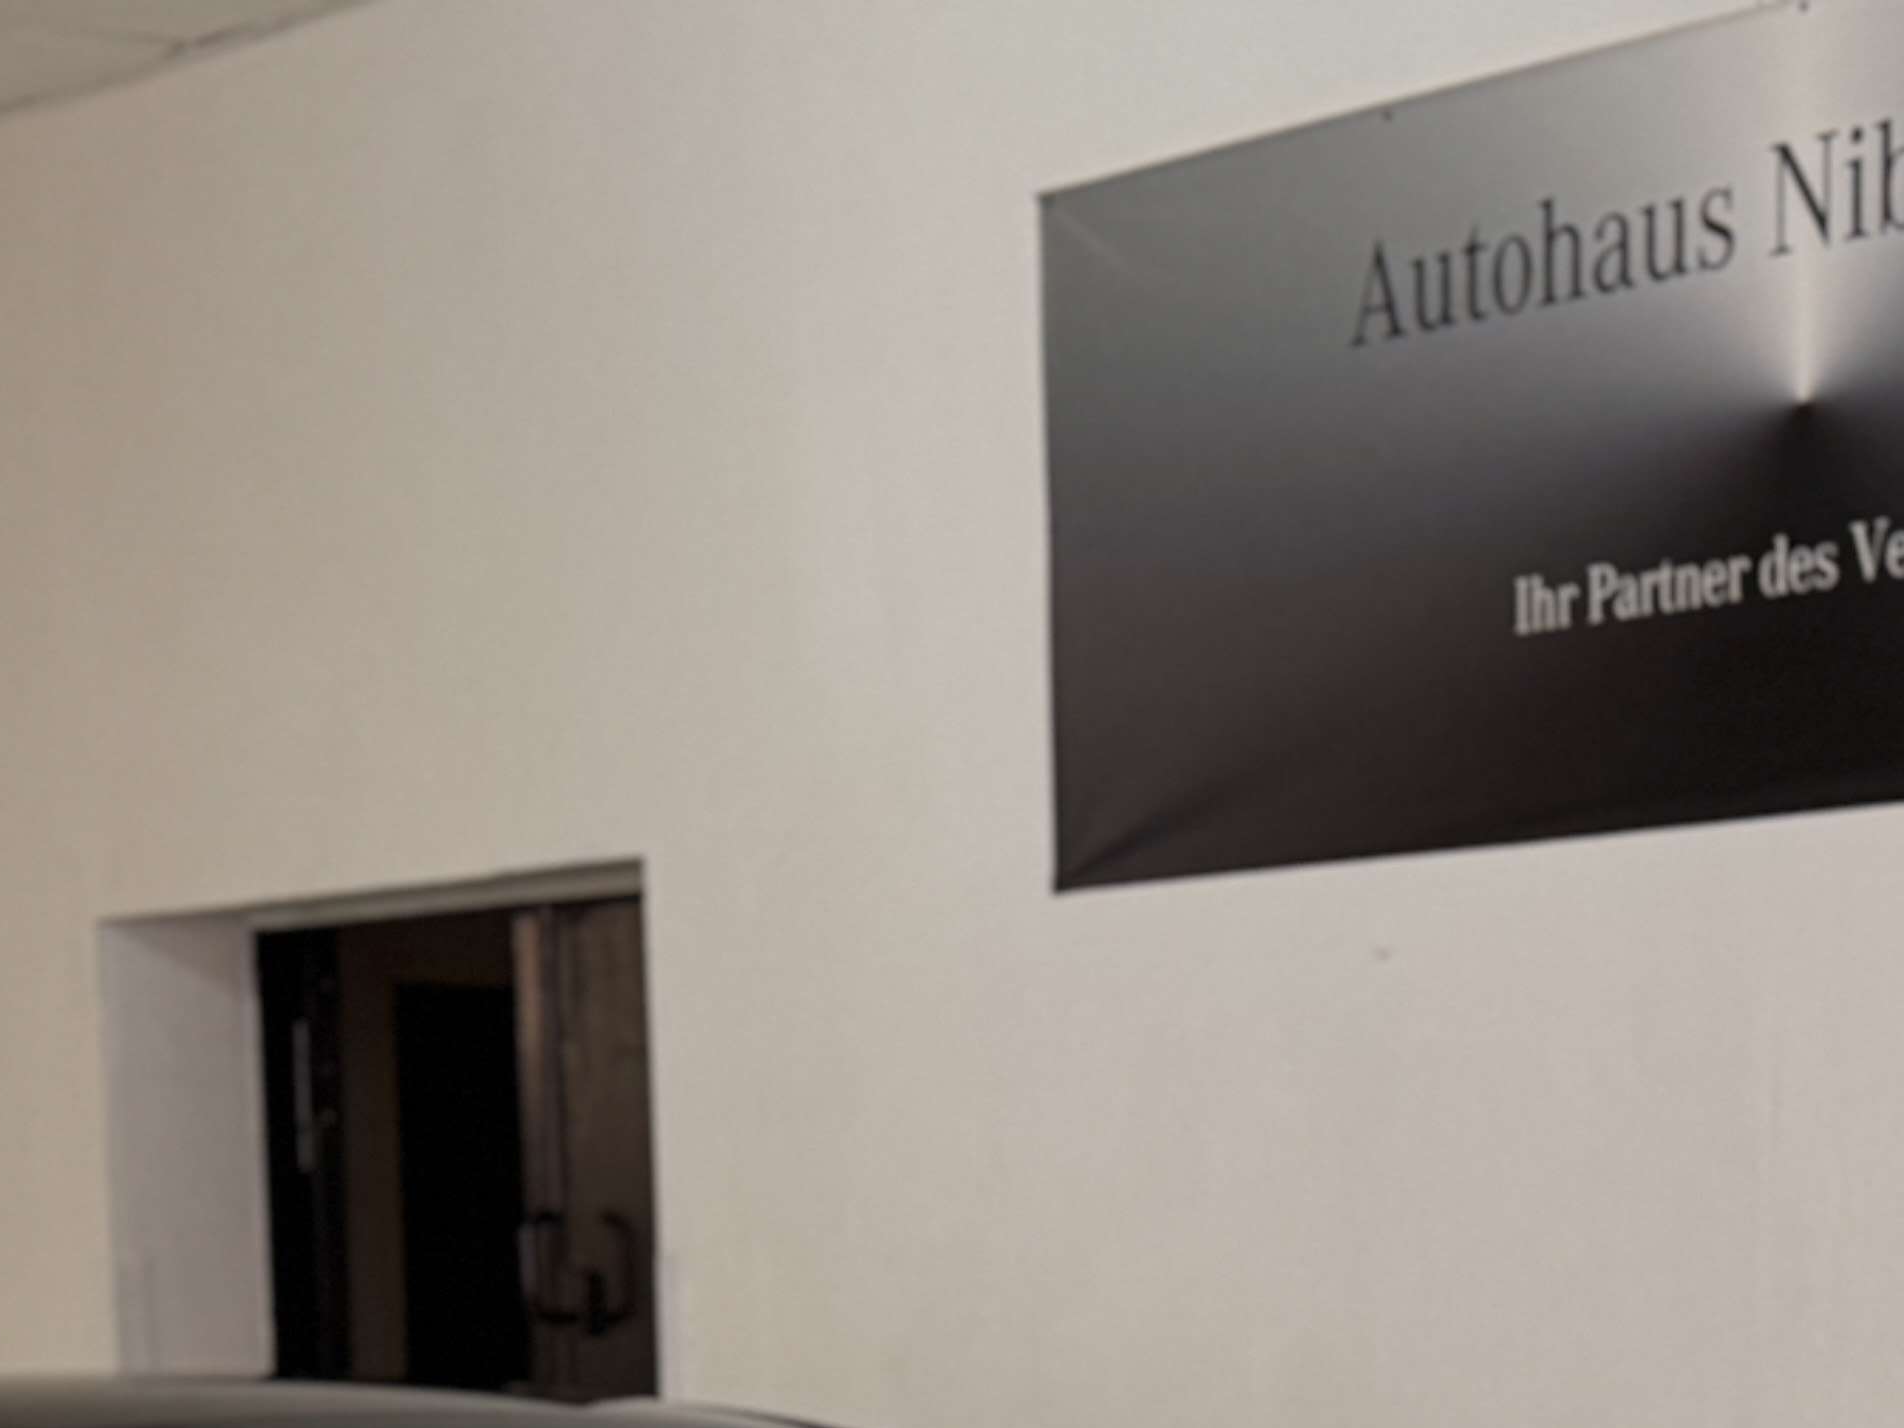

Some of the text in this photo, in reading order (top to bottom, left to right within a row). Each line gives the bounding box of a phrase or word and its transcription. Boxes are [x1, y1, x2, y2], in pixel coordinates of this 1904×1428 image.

[1348, 185, 1737, 349] Autohaus
[1514, 573, 1579, 636] Ihr
[1586, 553, 1752, 625] Partner
[1758, 533, 1839, 598] des
